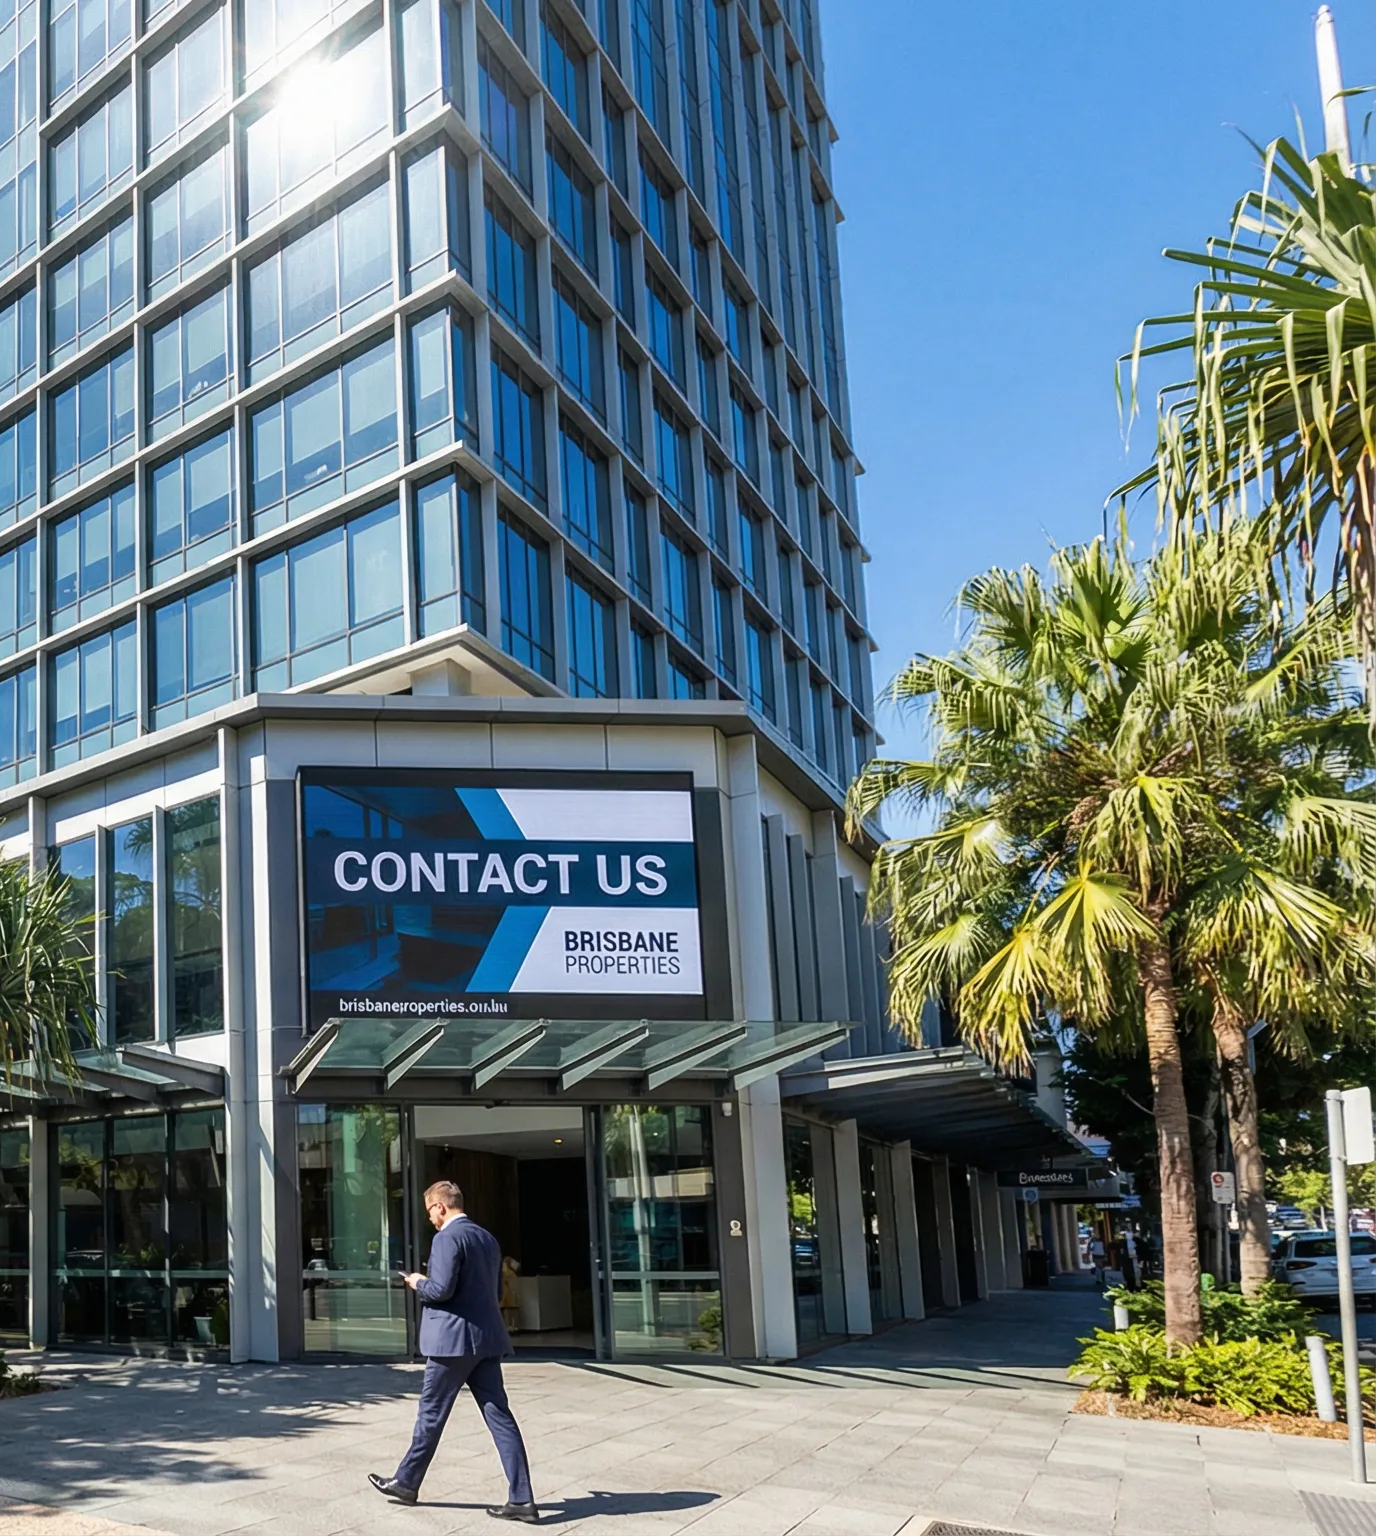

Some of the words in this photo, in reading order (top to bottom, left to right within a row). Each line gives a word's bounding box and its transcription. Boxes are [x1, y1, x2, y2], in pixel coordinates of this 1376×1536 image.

[333, 850, 580, 894] CONTACT
[596, 854, 668, 896] US
[564, 930, 679, 953] BRISBANE
[564, 954, 682, 975] PROPERTIES
